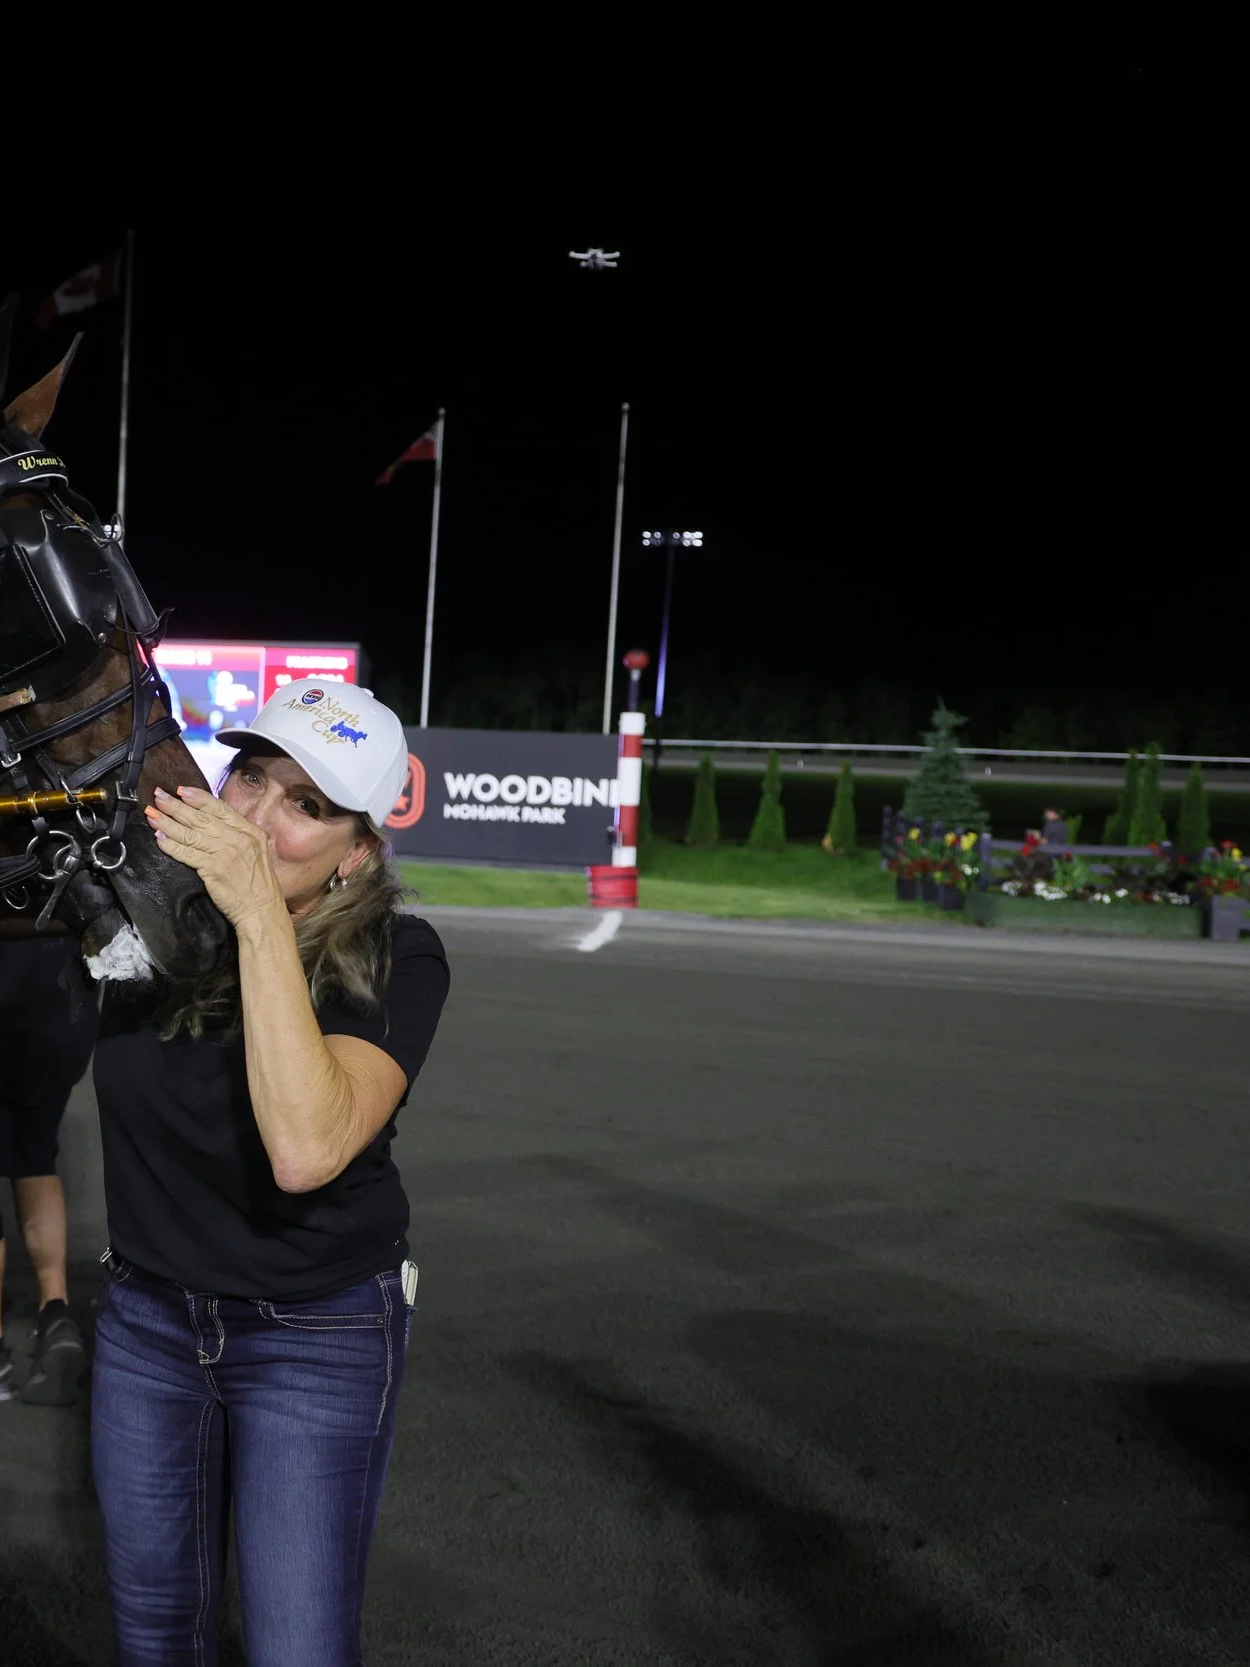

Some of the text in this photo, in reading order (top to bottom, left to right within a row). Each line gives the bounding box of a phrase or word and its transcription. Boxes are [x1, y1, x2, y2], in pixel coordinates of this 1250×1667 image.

[282, 698, 336, 724] America
[318, 696, 360, 728] North
[311, 720, 346, 745] Cup
[443, 803, 566, 824] MOHAWK PARK
